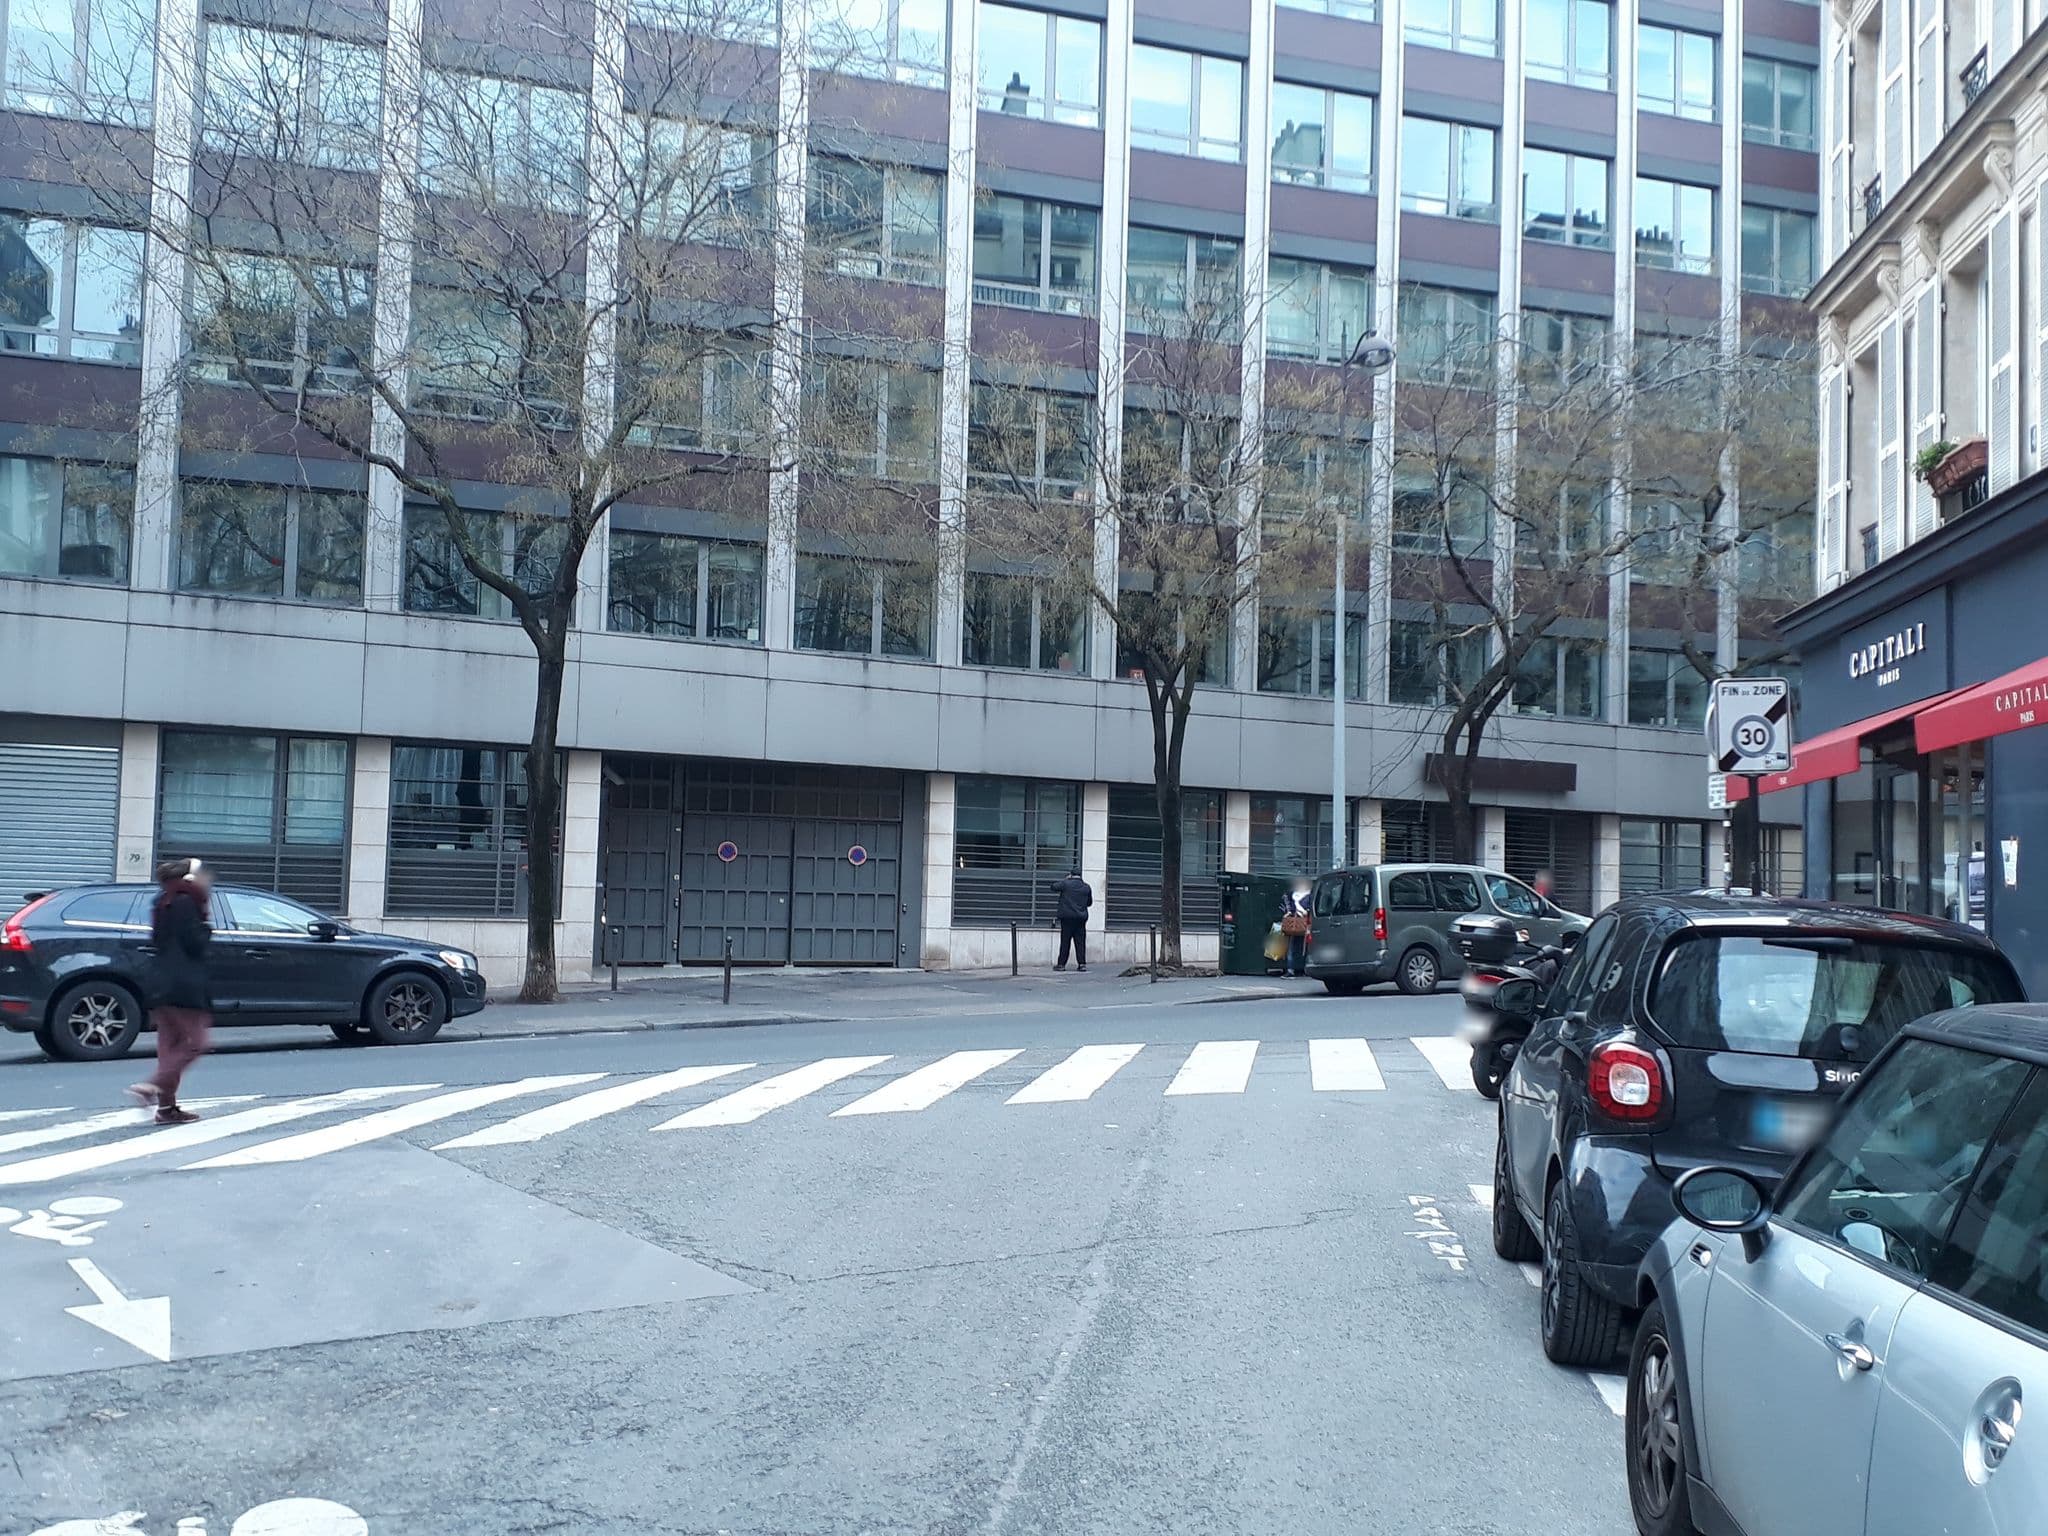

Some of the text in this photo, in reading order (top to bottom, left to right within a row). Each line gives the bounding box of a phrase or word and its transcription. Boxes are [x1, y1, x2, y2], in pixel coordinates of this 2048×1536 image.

[1849, 622, 1924, 678] CAPITALI
[1876, 667, 1900, 686] PARIS
[1721, 686, 1739, 696] FIN
[1752, 685, 1782, 696] ZONE
[2020, 710, 2035, 724] PARIS
[1740, 728, 1766, 746] 30
[128, 853, 141, 863] 79
